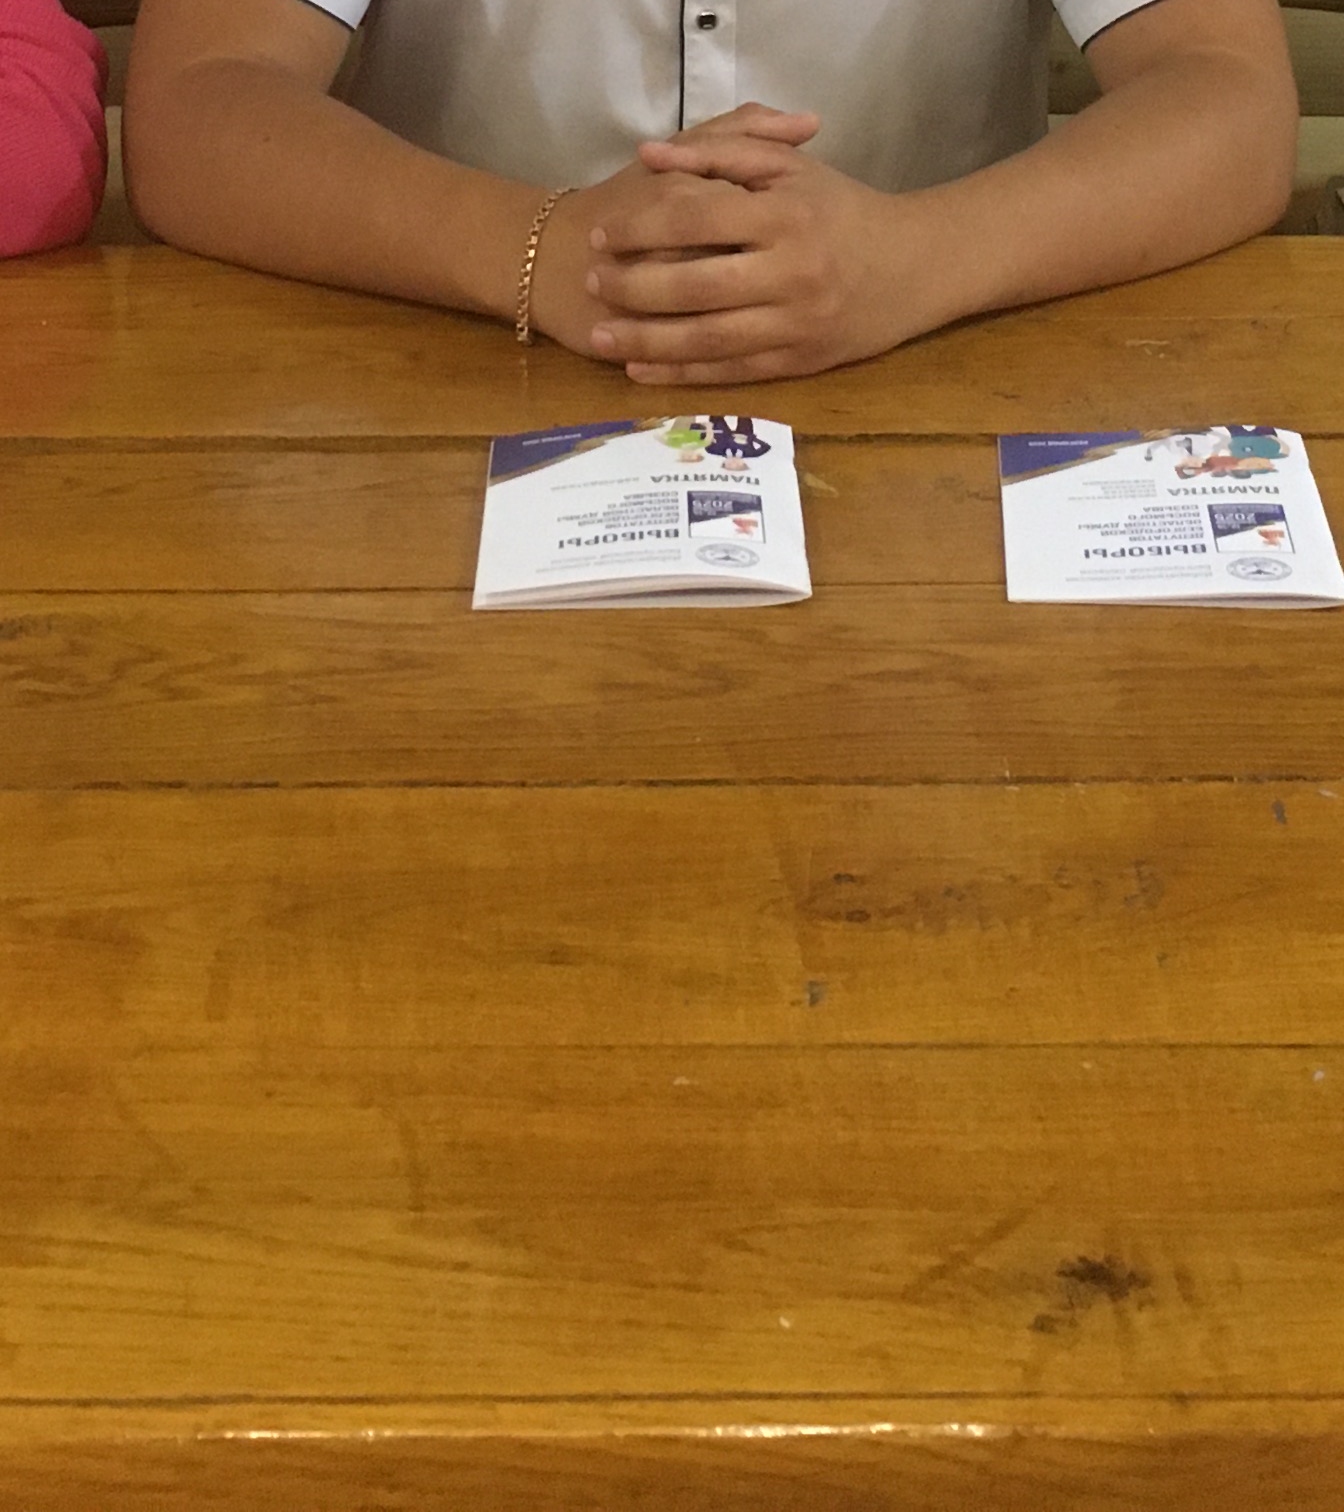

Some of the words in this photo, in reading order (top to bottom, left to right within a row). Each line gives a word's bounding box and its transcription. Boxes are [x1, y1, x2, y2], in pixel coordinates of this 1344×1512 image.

[650, 473, 760, 485] ПАМЯТКА
[1167, 485, 1279, 496] ПАМЯТКА
[558, 529, 679, 548] ВЫБОРЫ
[1084, 543, 1206, 559] ВЫБОРЫ
